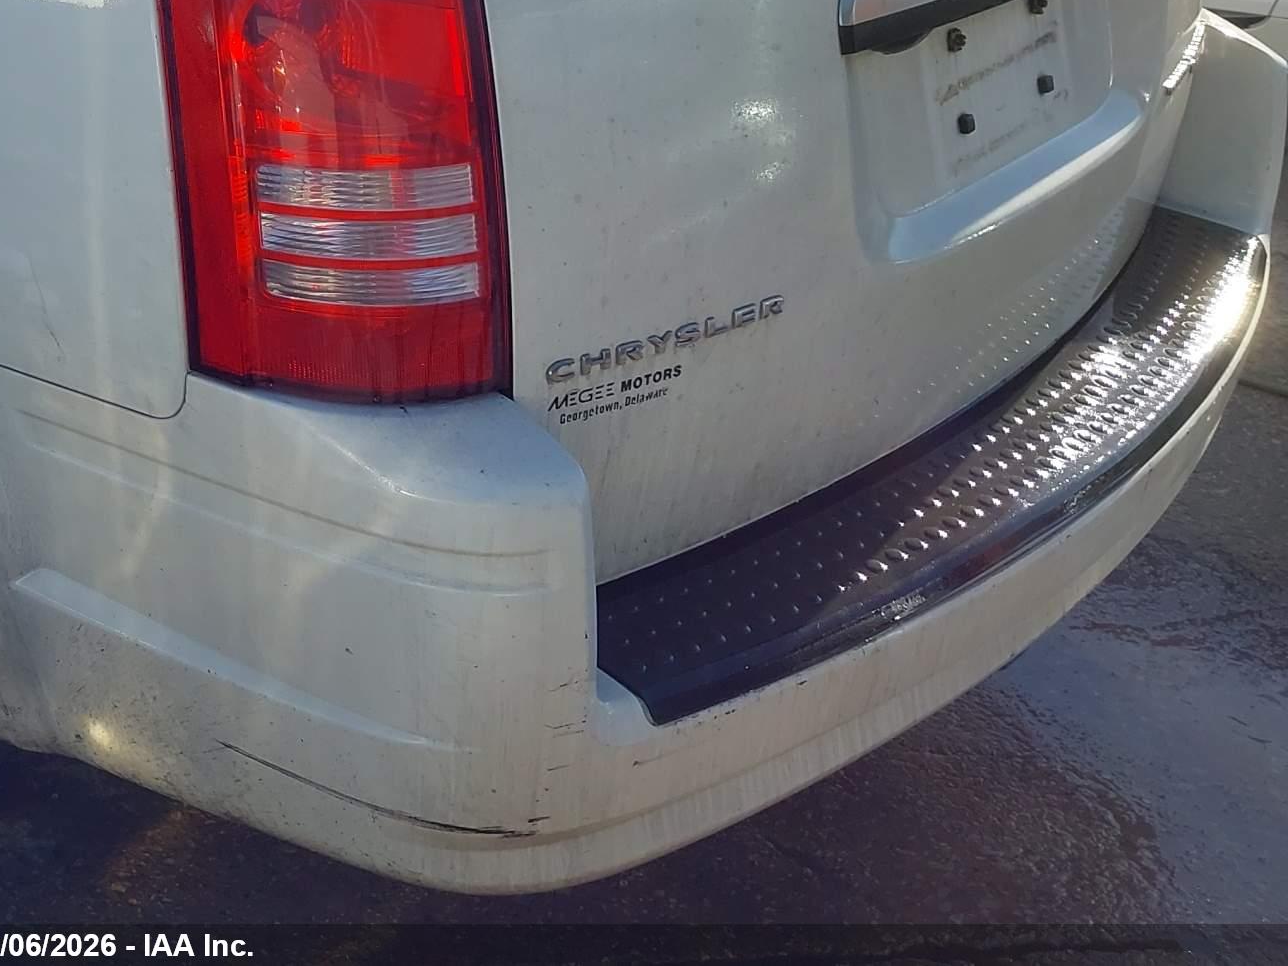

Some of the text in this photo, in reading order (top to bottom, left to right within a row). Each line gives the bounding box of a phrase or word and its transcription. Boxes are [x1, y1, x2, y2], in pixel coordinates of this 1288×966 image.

[545, 293, 785, 385] CHRYSLER
[548, 364, 683, 412] MEGEE MOTORS
[559, 387, 669, 425] Georgetown, Delaware
